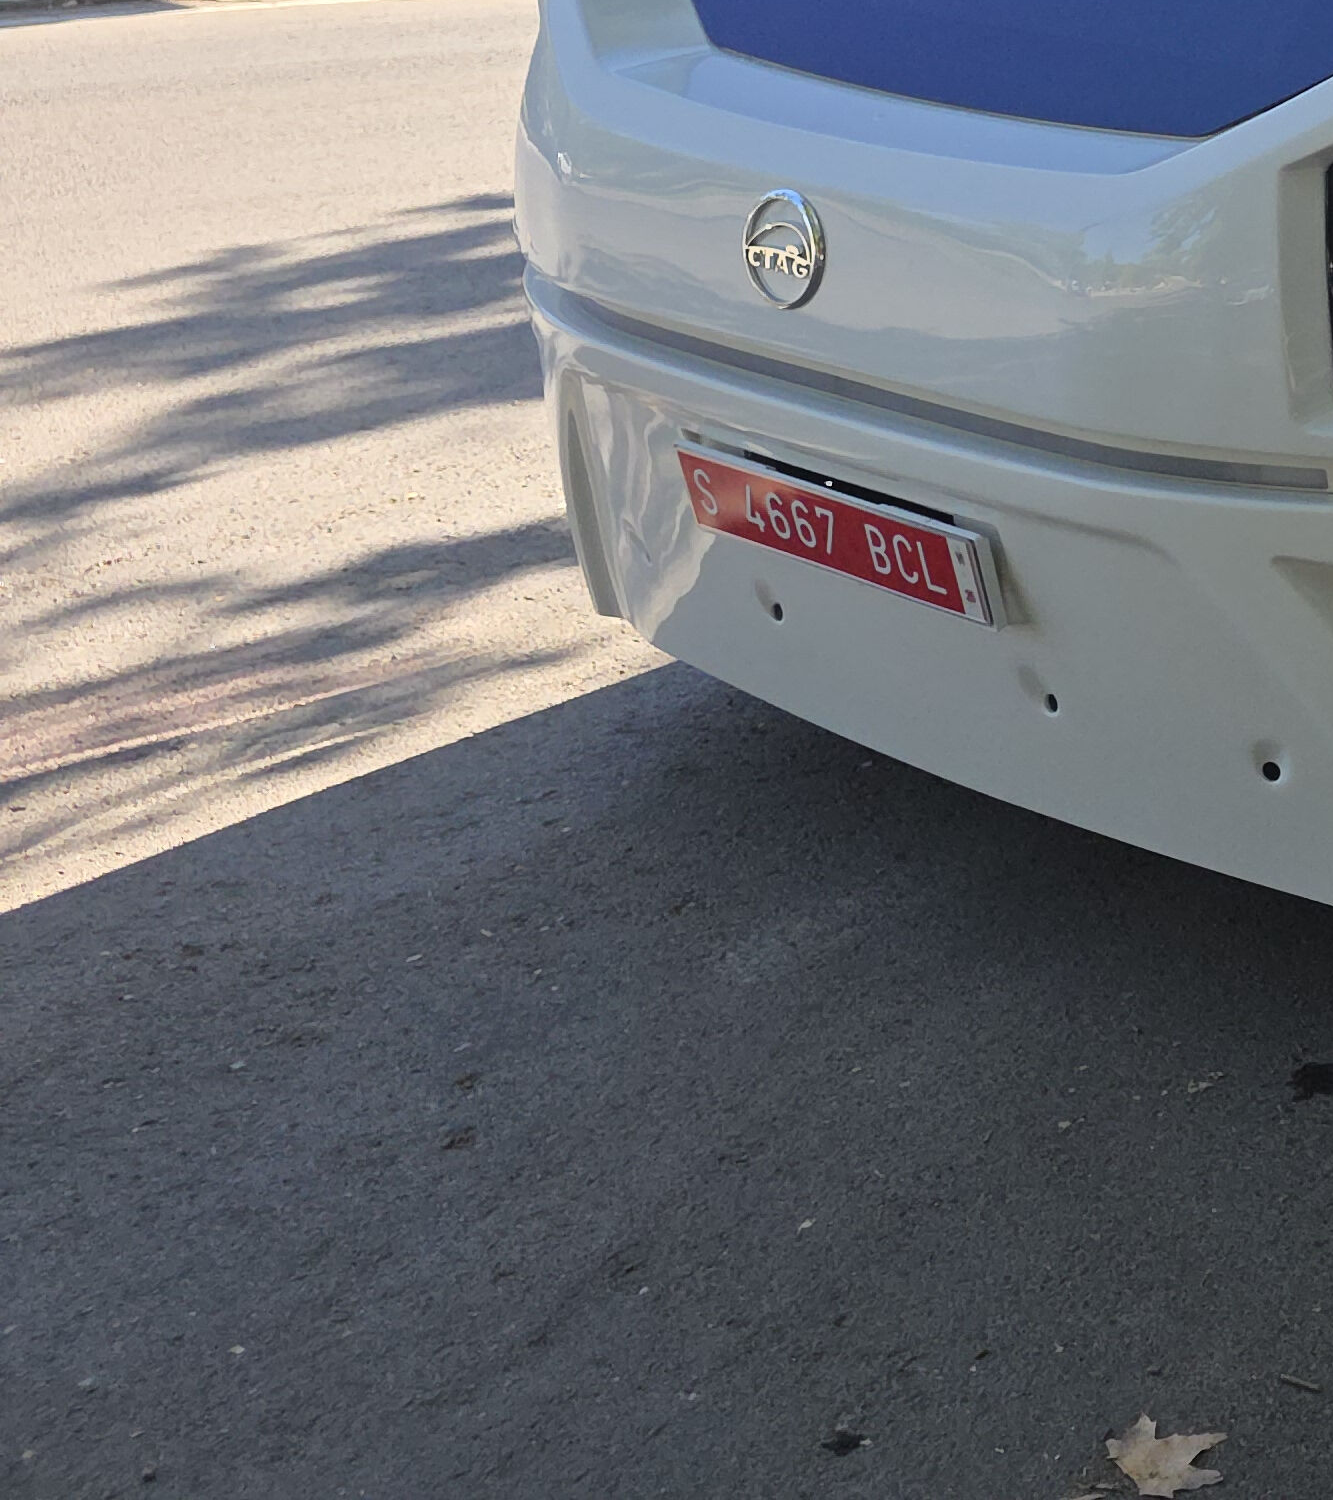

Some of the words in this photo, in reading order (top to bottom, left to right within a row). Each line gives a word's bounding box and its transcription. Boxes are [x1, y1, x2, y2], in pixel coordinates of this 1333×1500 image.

[746, 245, 812, 280] CTAG
[693, 467, 719, 517] S
[744, 485, 835, 556] 4667
[864, 522, 948, 597] BCL
